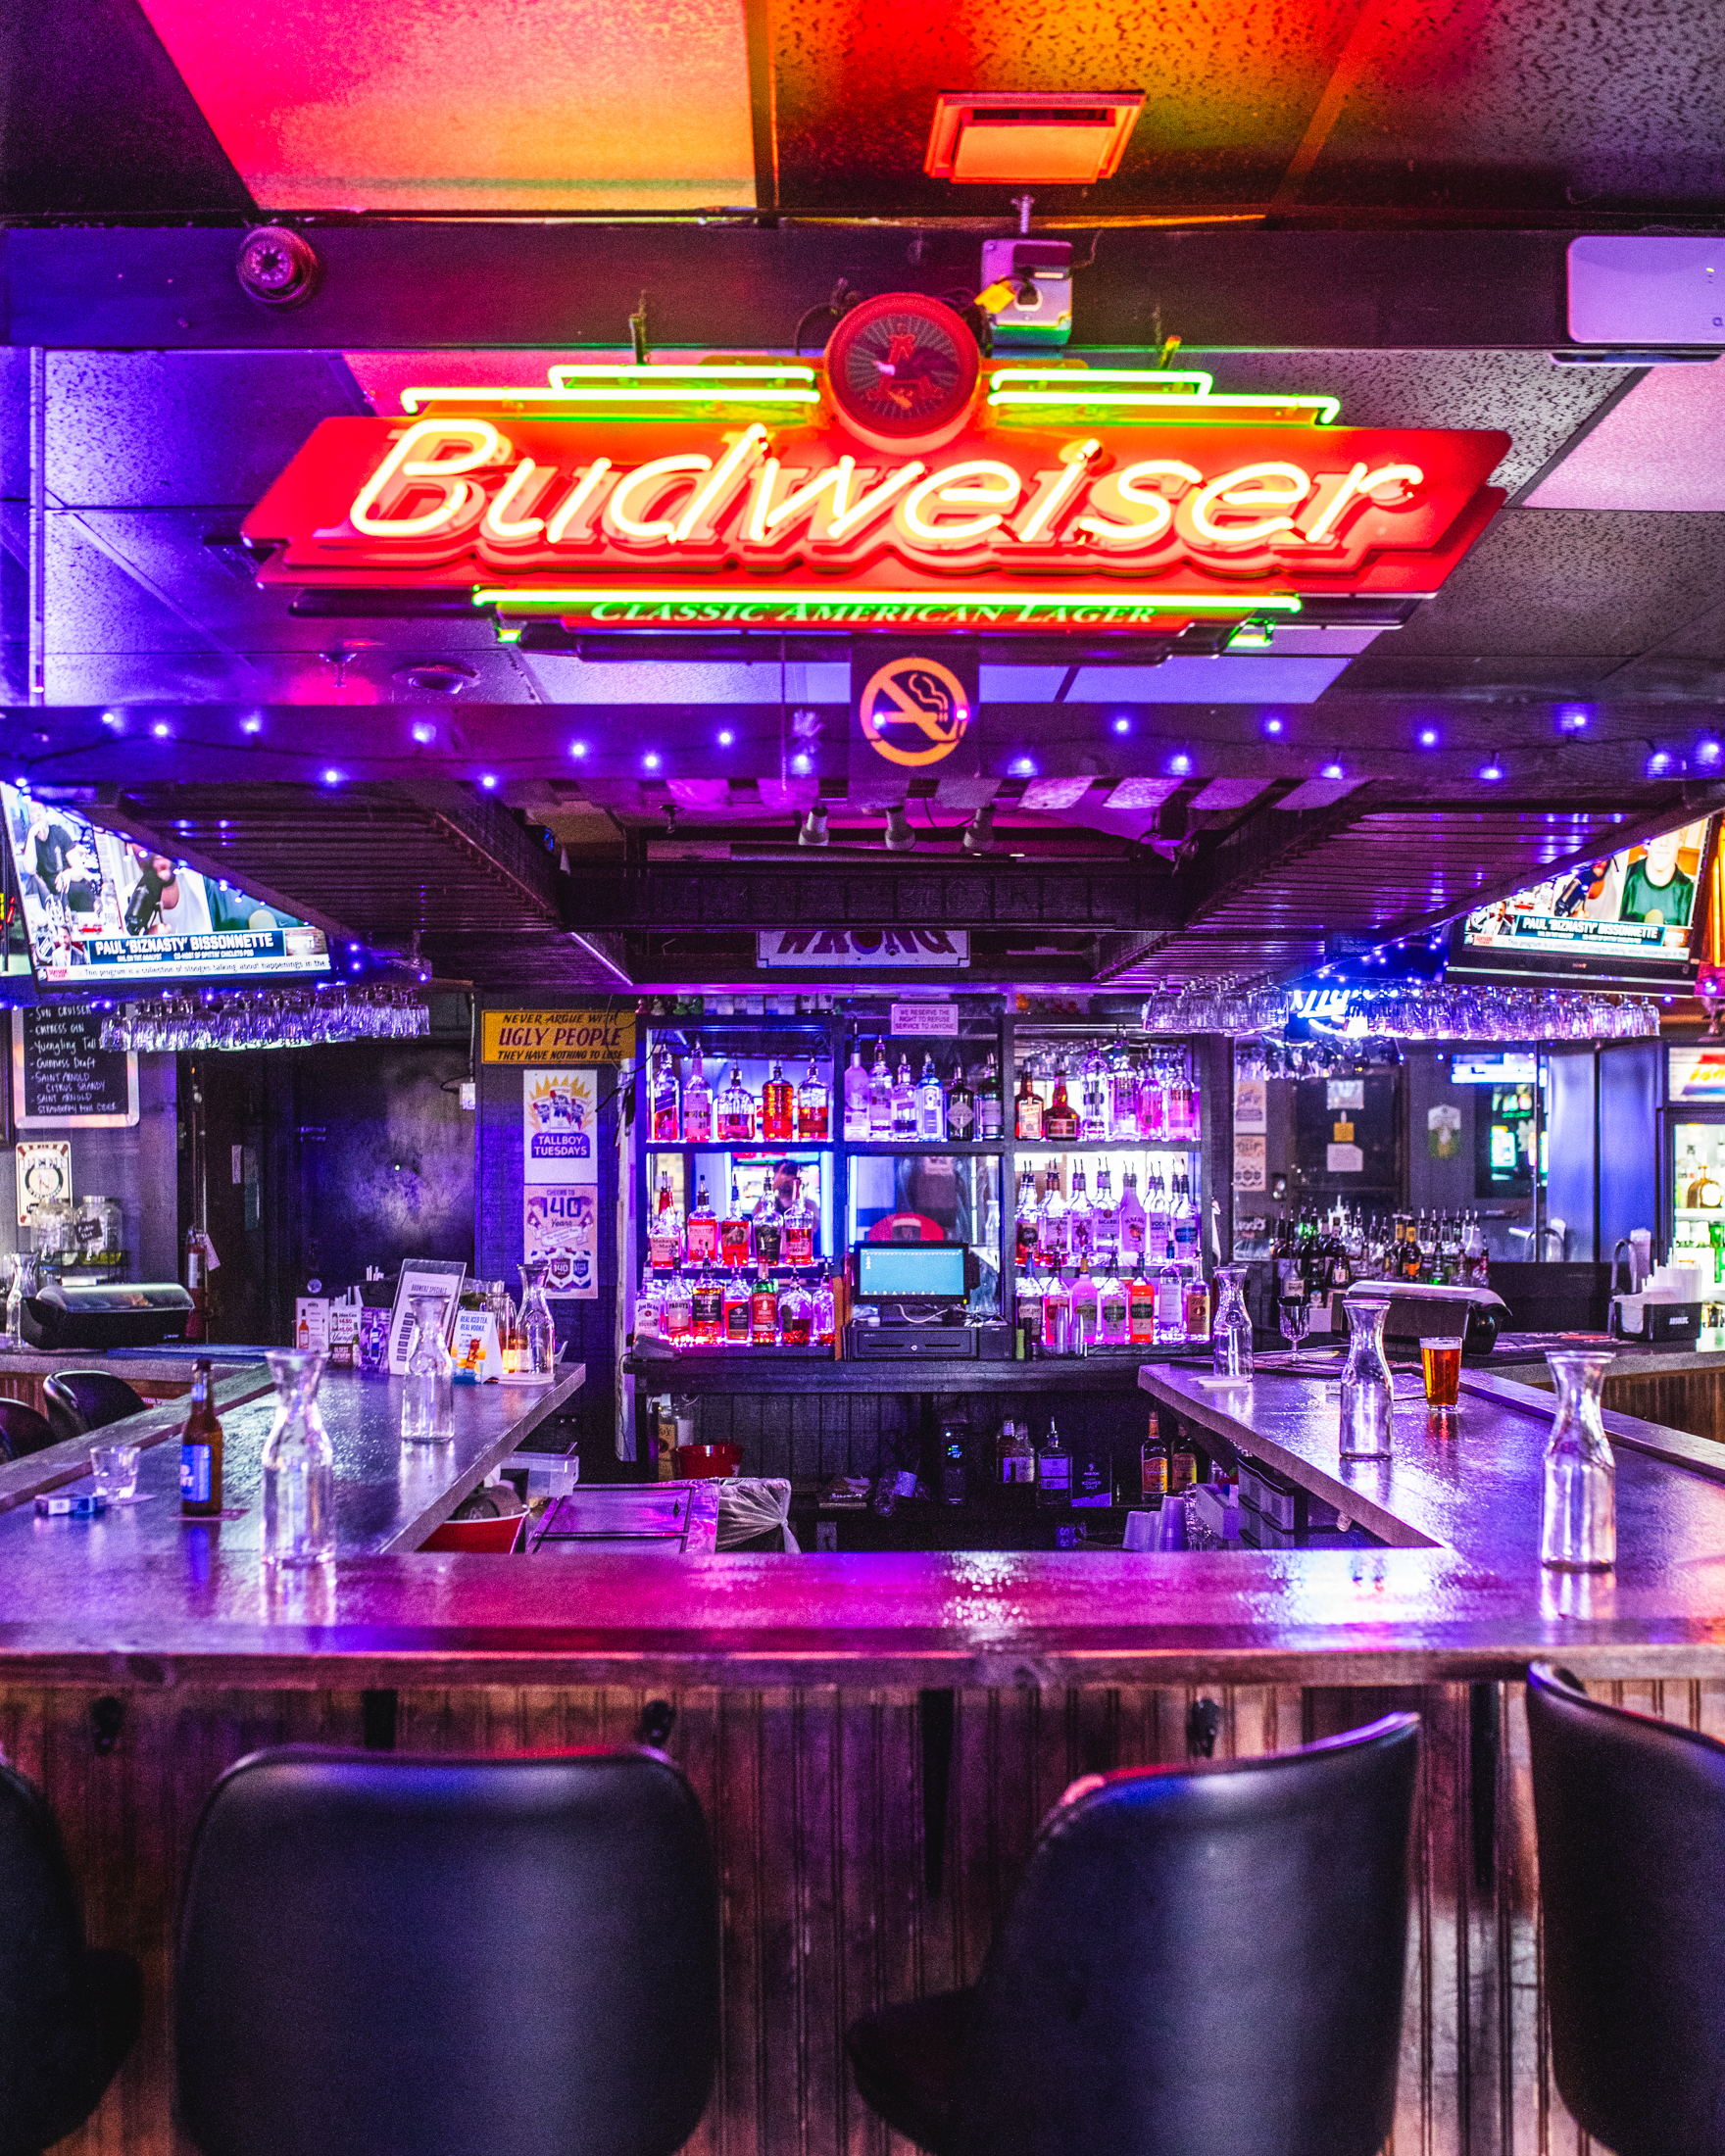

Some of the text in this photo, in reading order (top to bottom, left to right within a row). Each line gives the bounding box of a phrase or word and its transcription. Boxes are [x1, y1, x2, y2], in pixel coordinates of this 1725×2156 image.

[347, 416, 1426, 549] Budweiser
[590, 603, 1157, 623] CLASSIC AMERICAN LAGER
[1522, 917, 1548, 930] PAUL
[95, 940, 125, 956] PAUL
[189, 932, 274, 951] BISSONNETTE
[503, 1014, 542, 1024] NEVER
[546, 1014, 583, 1024] ARGUE
[499, 1027, 621, 1046] UGLY PEOPLE
[498, 1051, 622, 1059] THEY HAVE NOTHING TO LOSE
[538, 1136, 583, 1145] TALLBOY
[534, 1146, 587, 1156] TUESDAYS
[541, 1198, 582, 1217] 140
[551, 1218, 573, 1228] Years
[554, 1263, 568, 1273] 140
[647, 1302, 660, 1311] BEAM
